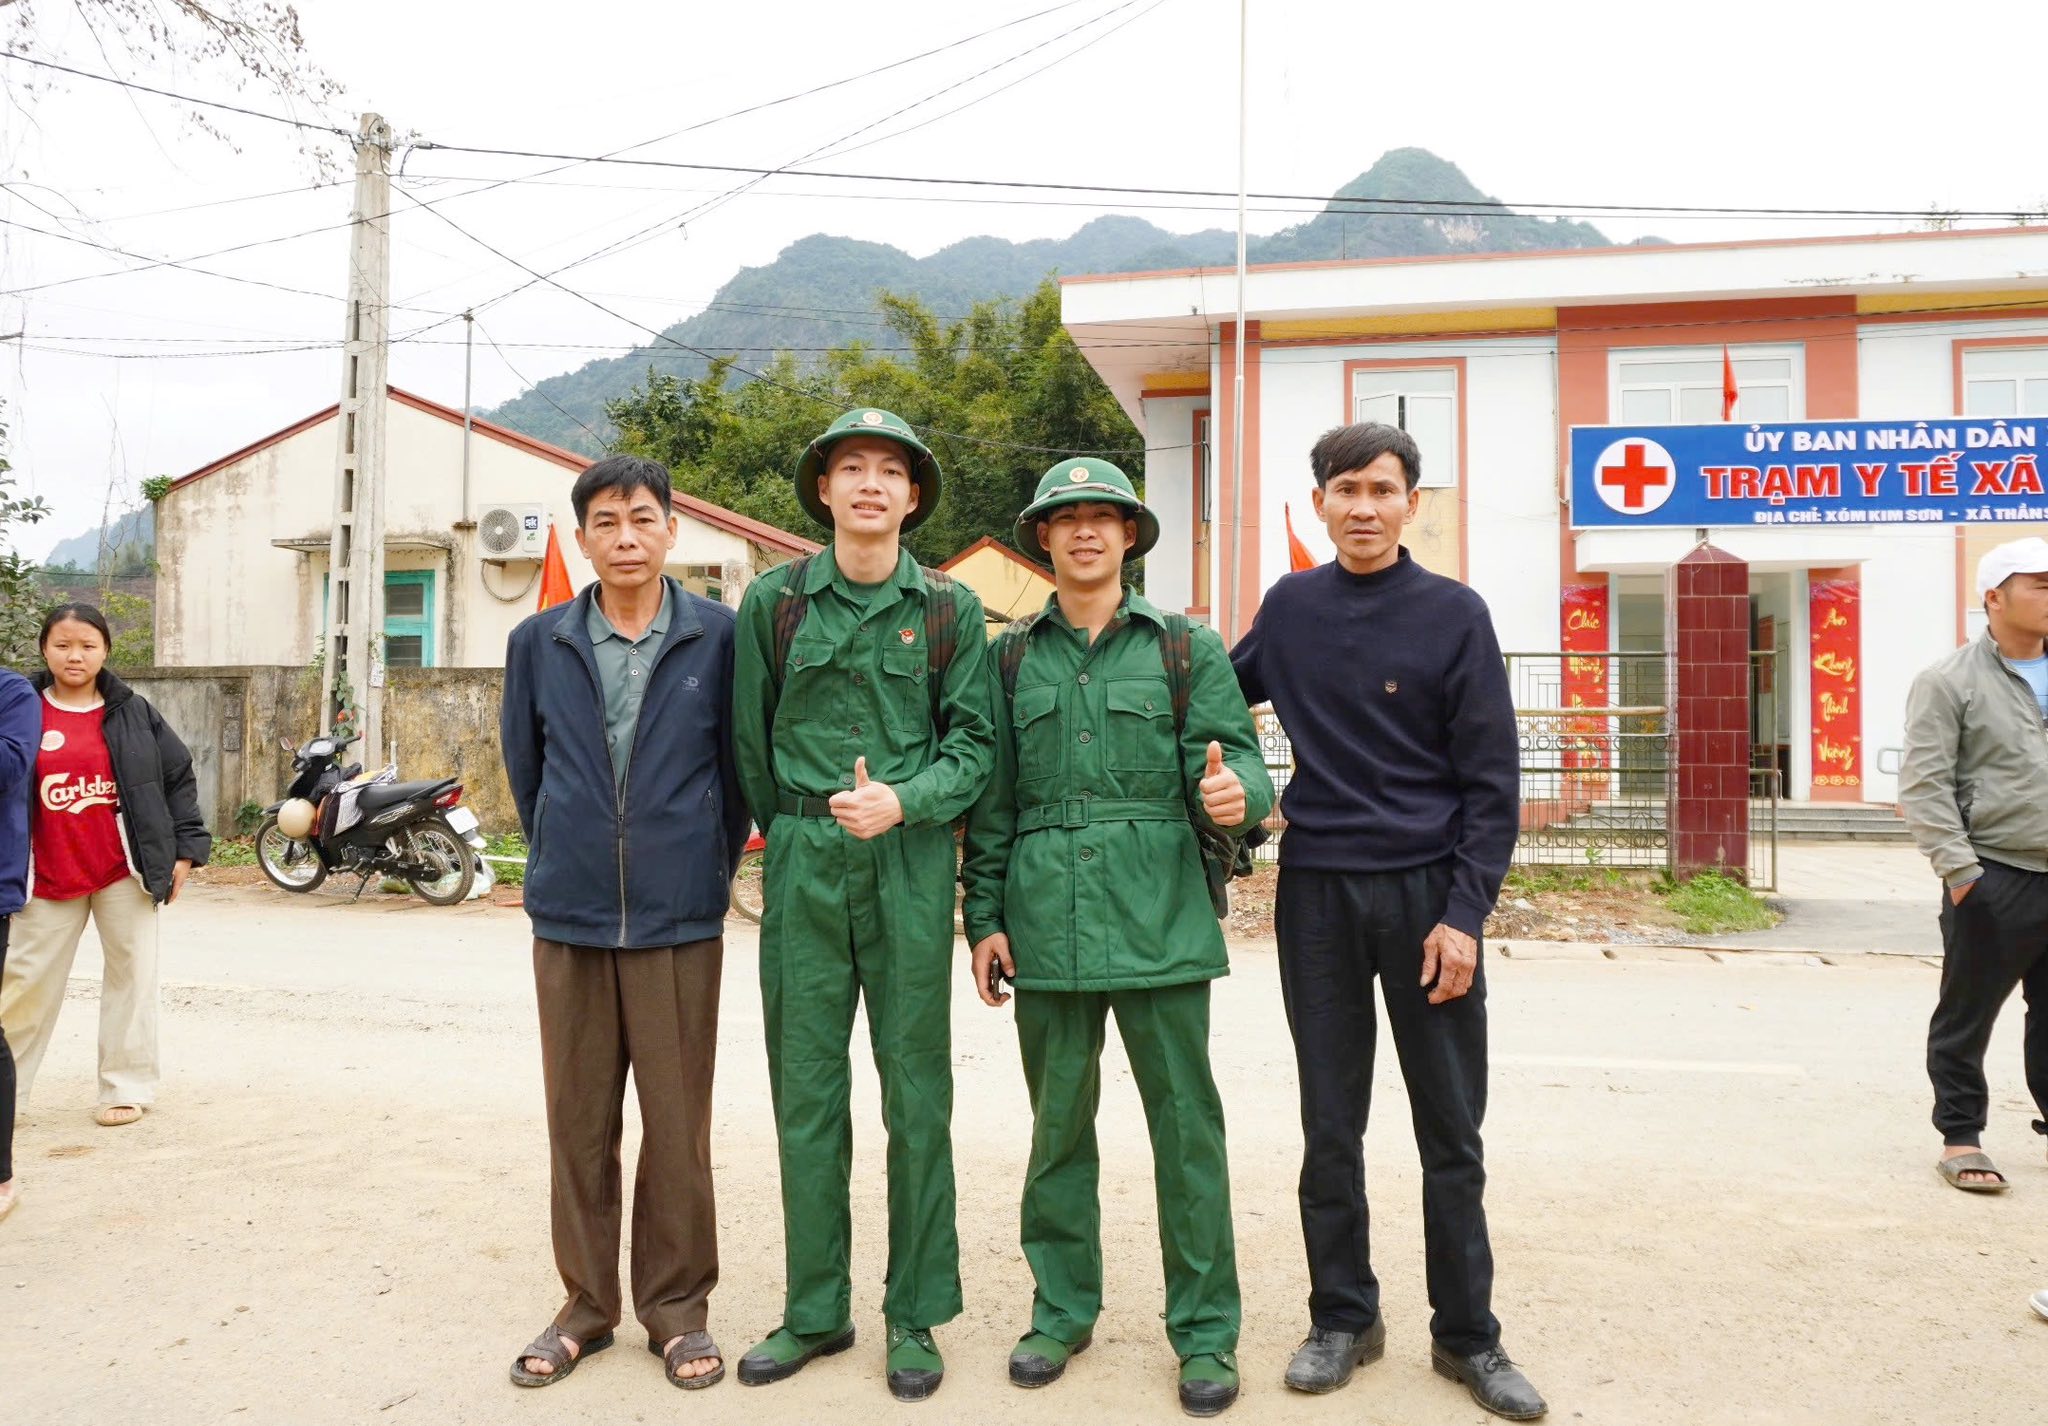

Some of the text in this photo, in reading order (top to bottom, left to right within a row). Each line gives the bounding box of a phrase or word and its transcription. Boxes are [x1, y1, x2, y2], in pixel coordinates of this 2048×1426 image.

[1745, 424, 1784, 452] ỦY
[1792, 430, 1856, 451] BAN
[1866, 421, 1956, 450] NHÂN
[1966, 420, 2035, 448] DÂN
[1700, 451, 2045, 506] TRẠM Y TẾ XÃ
[1754, 511, 1785, 525] ĐỊA
[1825, 508, 1866, 522] XÓM
[1868, 509, 1903, 522] KIM
[1905, 508, 1944, 521] SƠN
[1965, 505, 1993, 520] XÃ
[1568, 608, 1600, 630] Chúc
[1813, 652, 1856, 682] Khang
